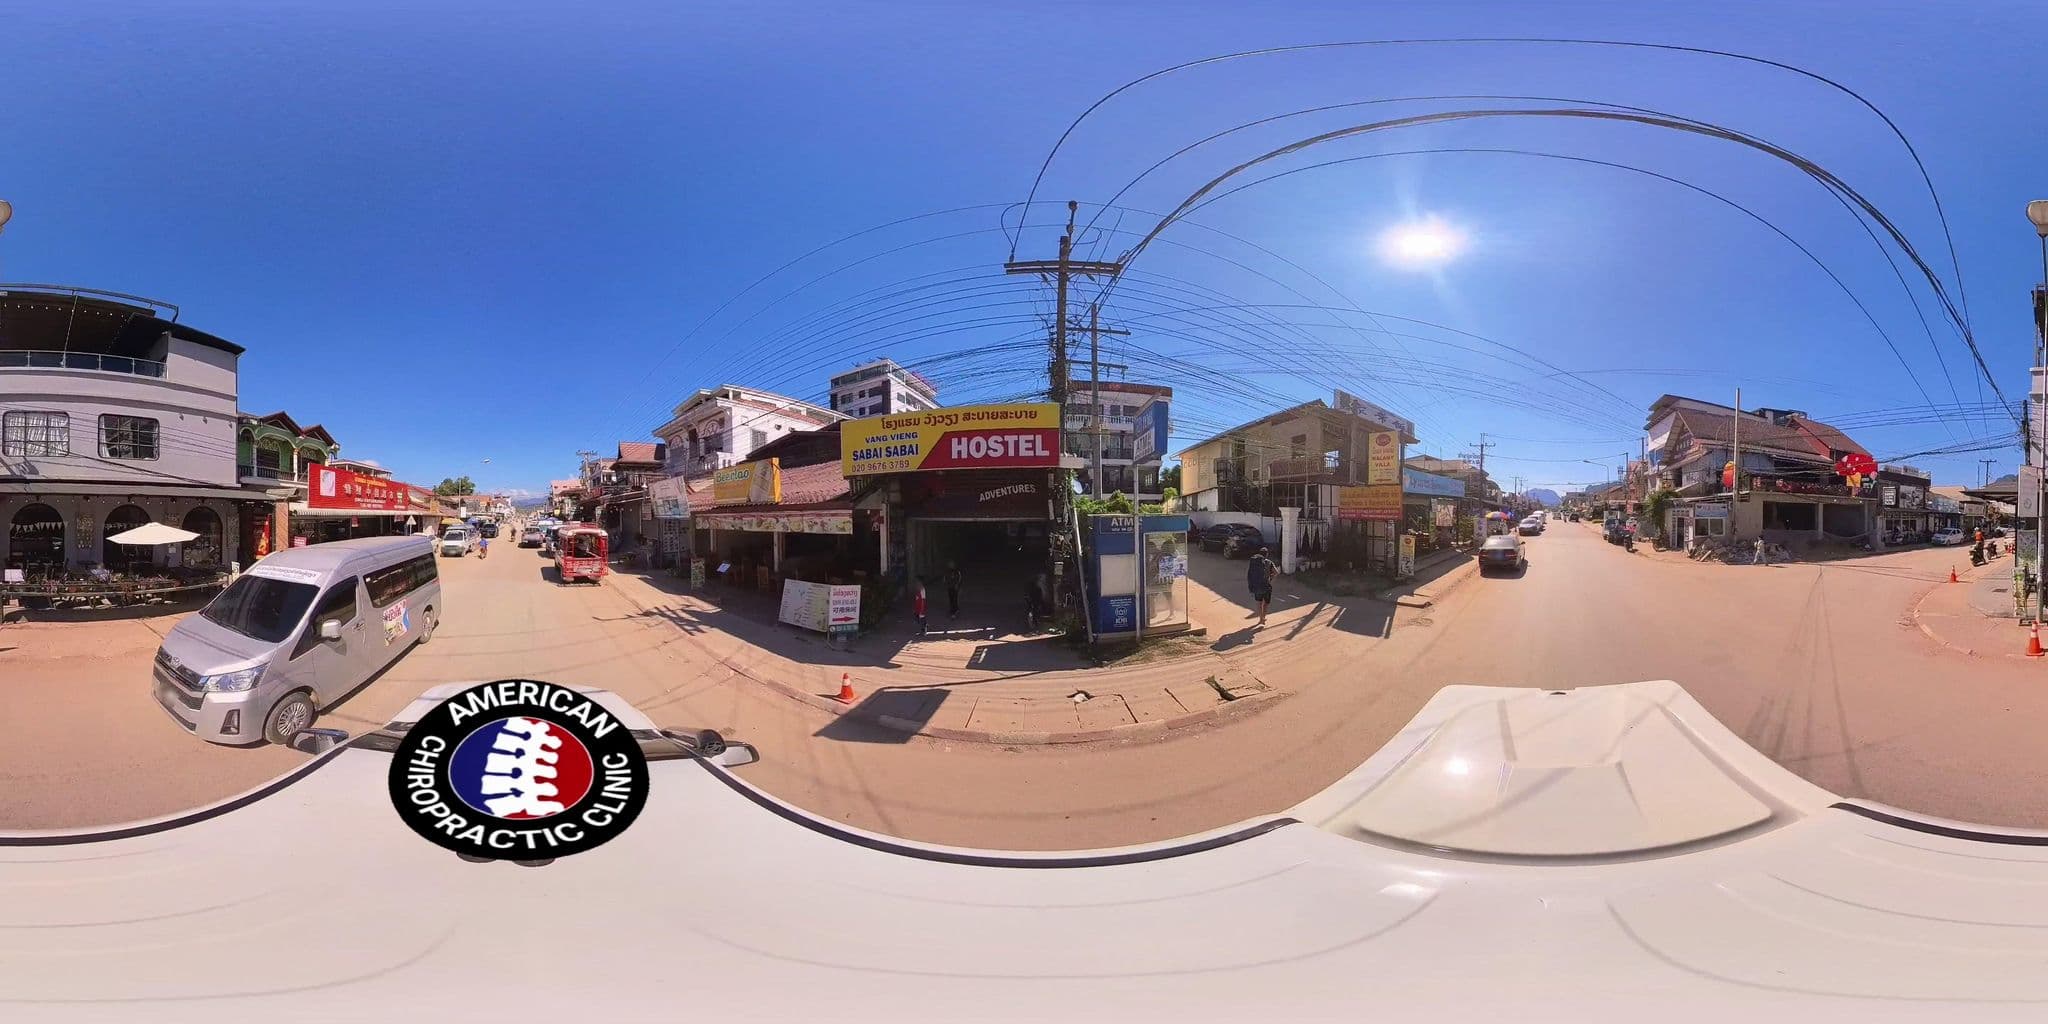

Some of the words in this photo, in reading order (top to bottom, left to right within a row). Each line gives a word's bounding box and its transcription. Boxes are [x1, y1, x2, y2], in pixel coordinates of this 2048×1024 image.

[865, 435, 888, 444] VANG
[890, 432, 918, 441] VIENG
[852, 447, 882, 461] SABAI
[885, 443, 919, 458] SABAI
[951, 434, 1050, 459] HOSTEL
[851, 463, 865, 473] 020
[979, 484, 1036, 502] ADVENTURES
[1111, 517, 1134, 527] ATM
